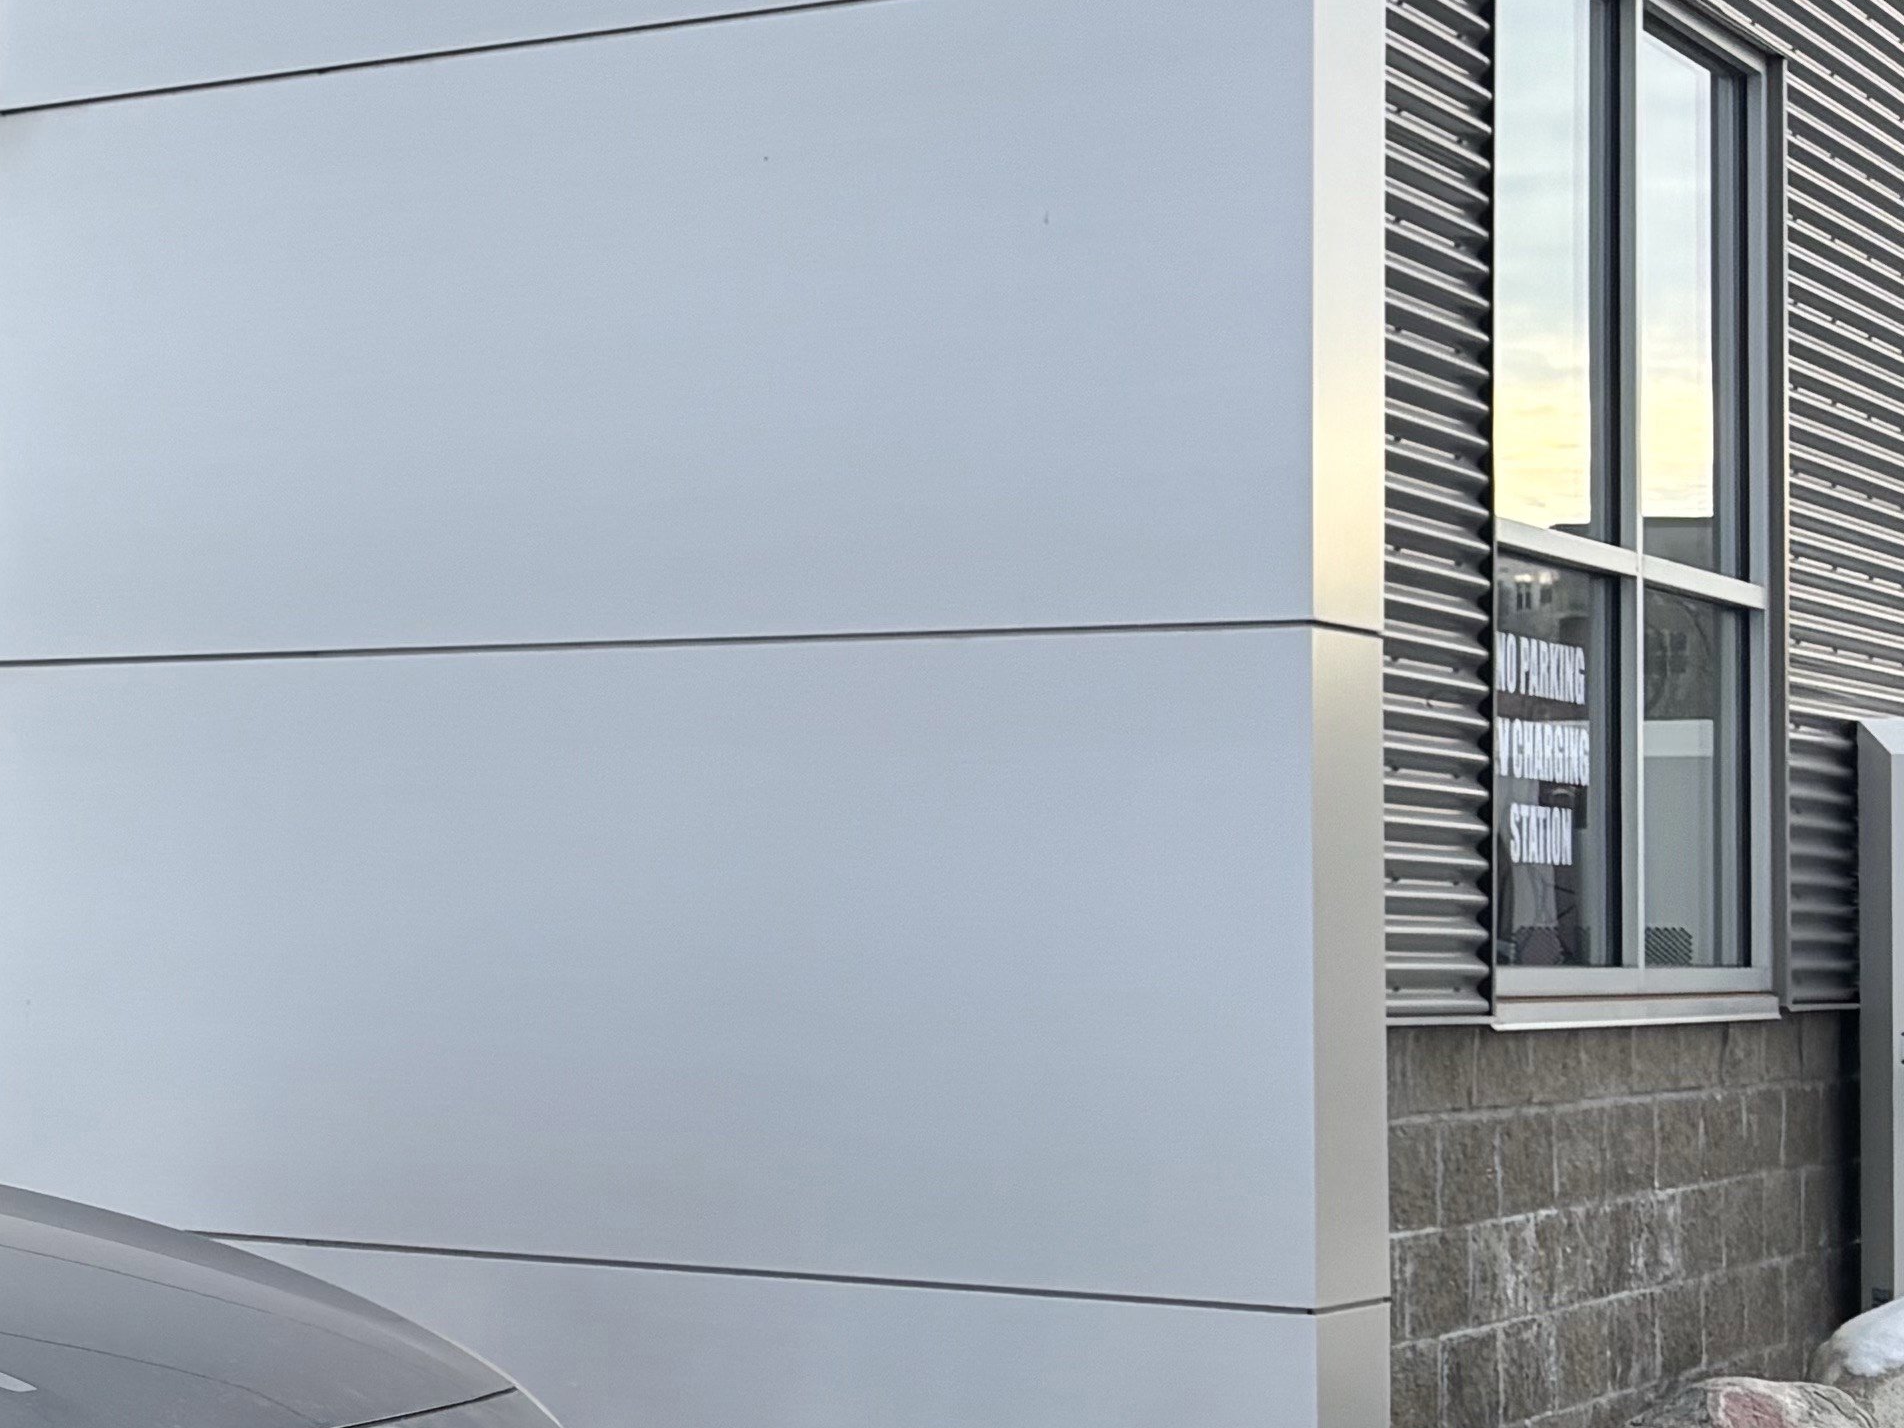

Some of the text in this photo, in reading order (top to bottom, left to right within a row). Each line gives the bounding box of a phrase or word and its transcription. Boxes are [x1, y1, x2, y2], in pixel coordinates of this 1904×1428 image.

[1495, 631, 1586, 706] NO PARKING
[1495, 716, 1590, 787] V CHARGING
[1509, 802, 1573, 866] STATION
